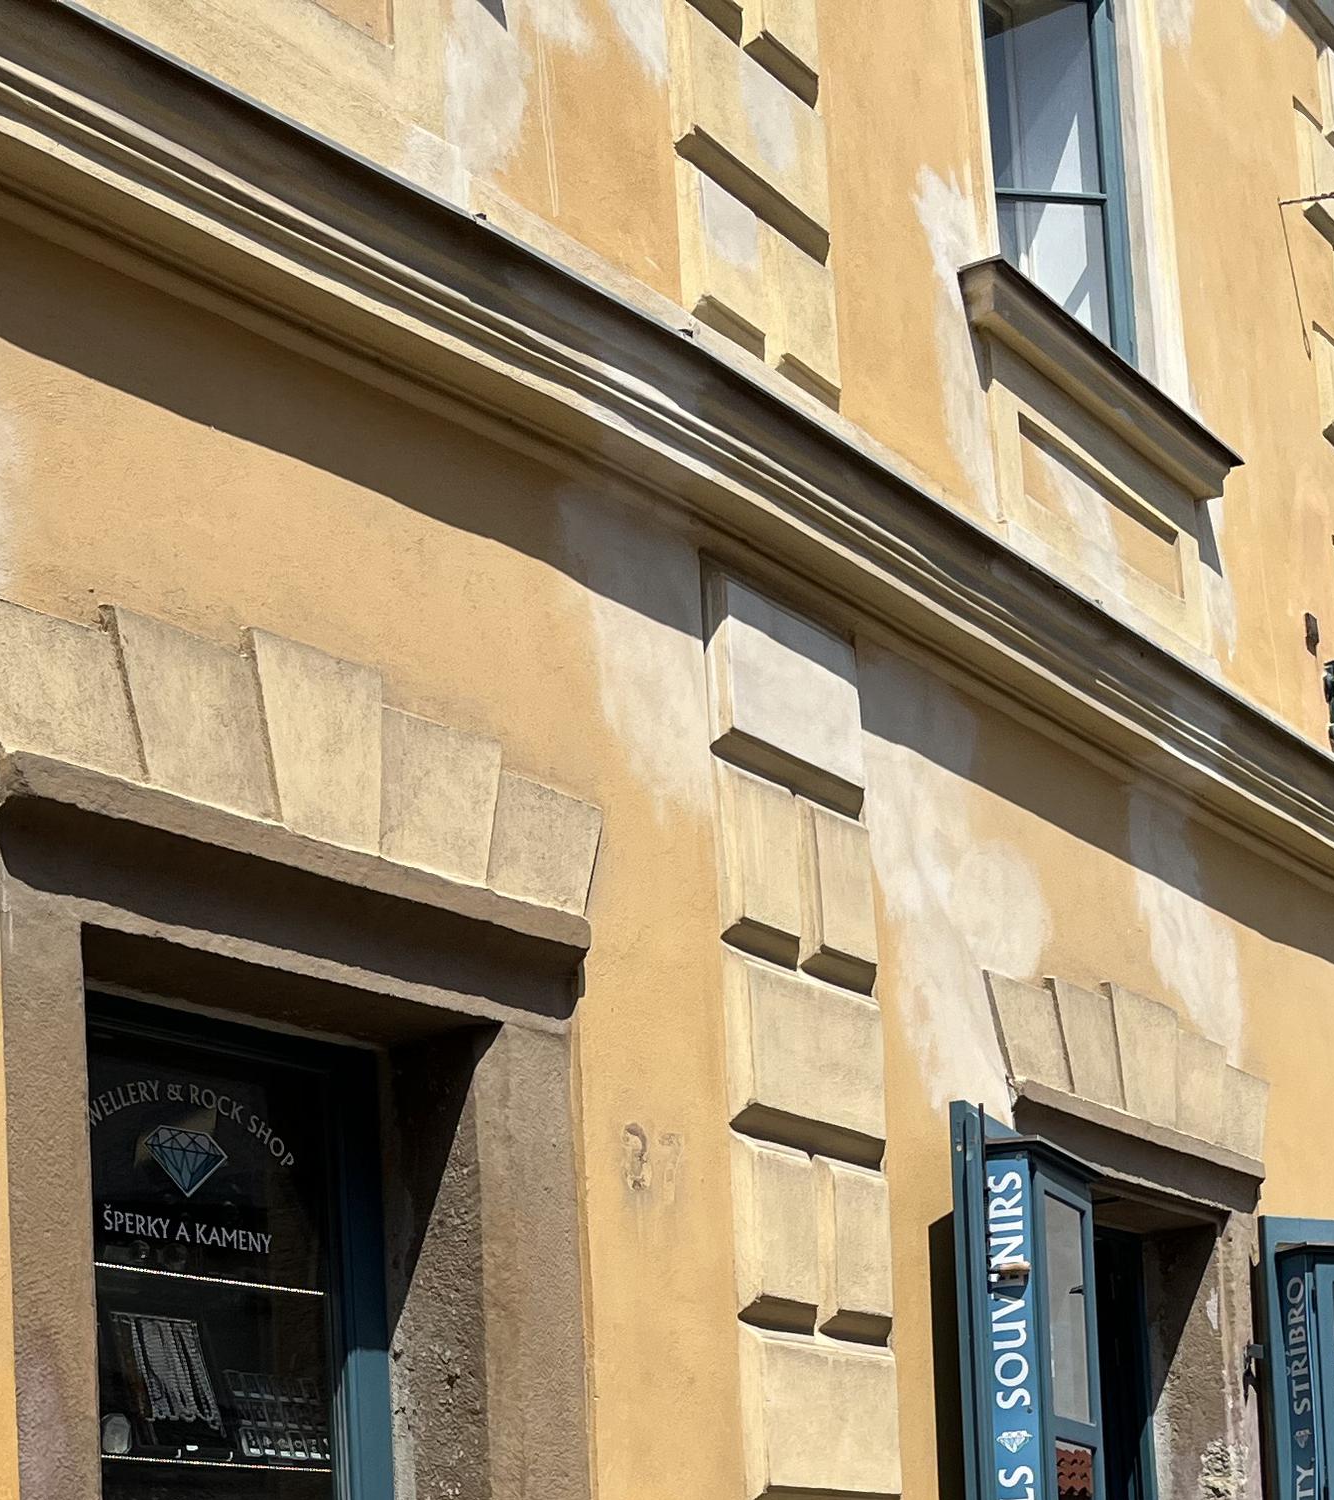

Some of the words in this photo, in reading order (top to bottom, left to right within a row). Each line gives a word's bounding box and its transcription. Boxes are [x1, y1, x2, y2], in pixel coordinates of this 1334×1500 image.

[89, 1080, 160, 1127] WELLERY
[167, 1084, 183, 1101] &
[190, 1083, 244, 1124] ROCK
[247, 1114, 296, 1168] SHOP
[103, 1203, 170, 1239] ŠPERKY
[175, 1221, 191, 1243] A
[195, 1223, 273, 1254] KAMENY
[987, 1169, 1031, 1411] SOUVNIRS
[1284, 1276, 1311, 1416] STŘÍBRO
